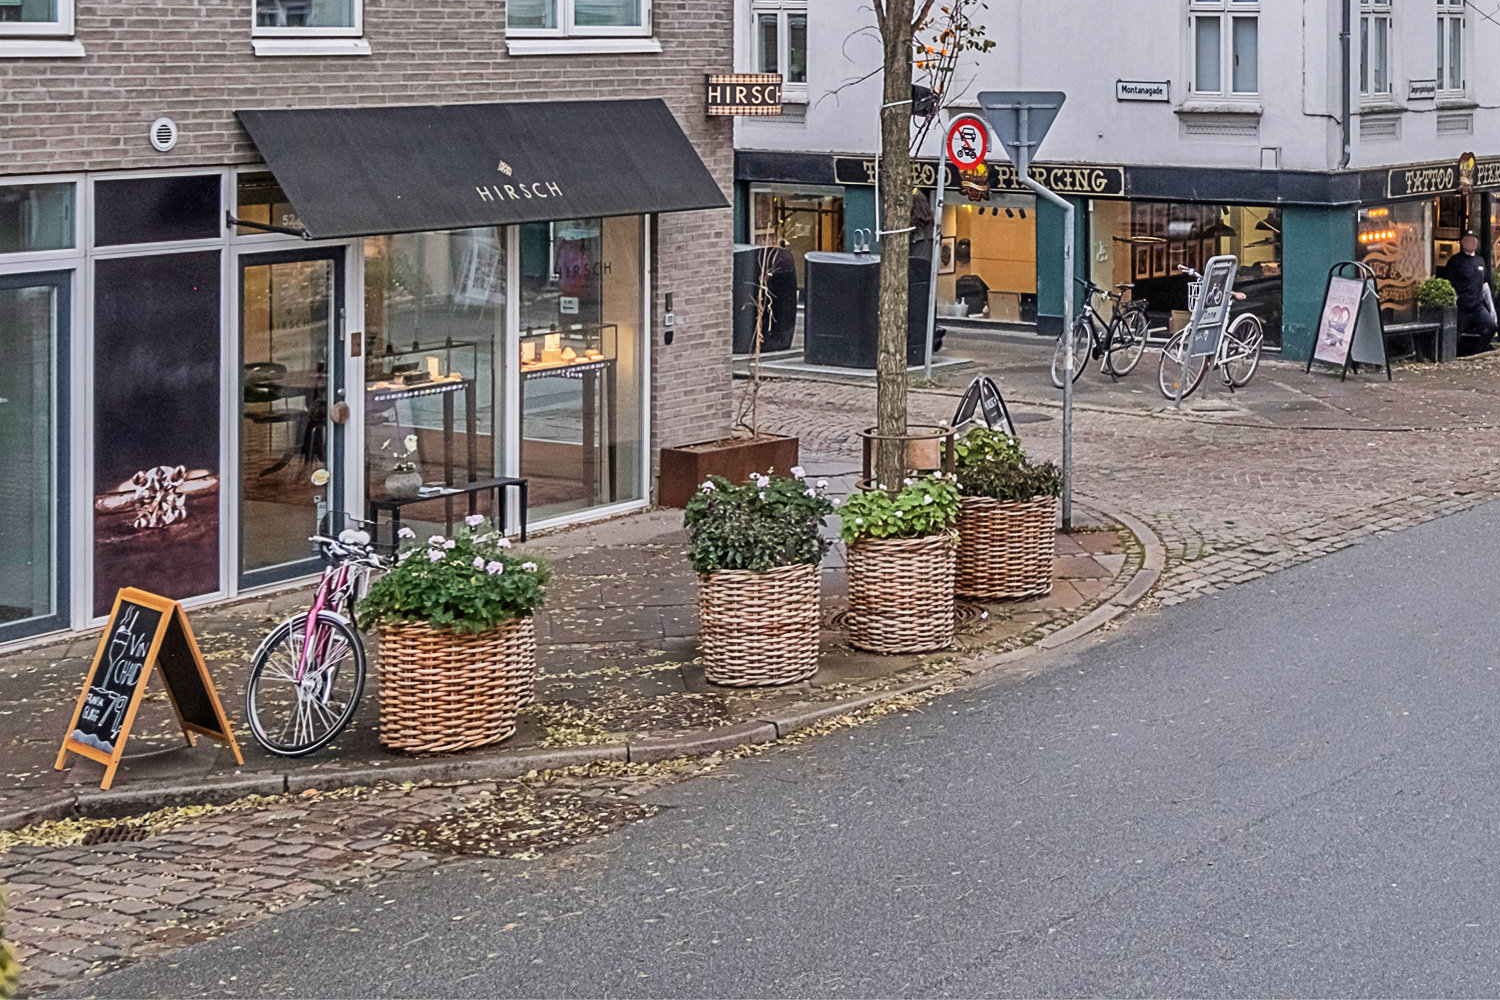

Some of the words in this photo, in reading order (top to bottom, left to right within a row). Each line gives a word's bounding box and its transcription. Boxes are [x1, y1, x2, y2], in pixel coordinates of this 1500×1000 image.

[1121, 85, 1163, 96] Montanagade
[994, 165, 1108, 192] PIRCING
[1405, 168, 1454, 194] TATTOO
[475, 181, 563, 201] HIRSCH
[554, 261, 612, 280] HIRSCH
